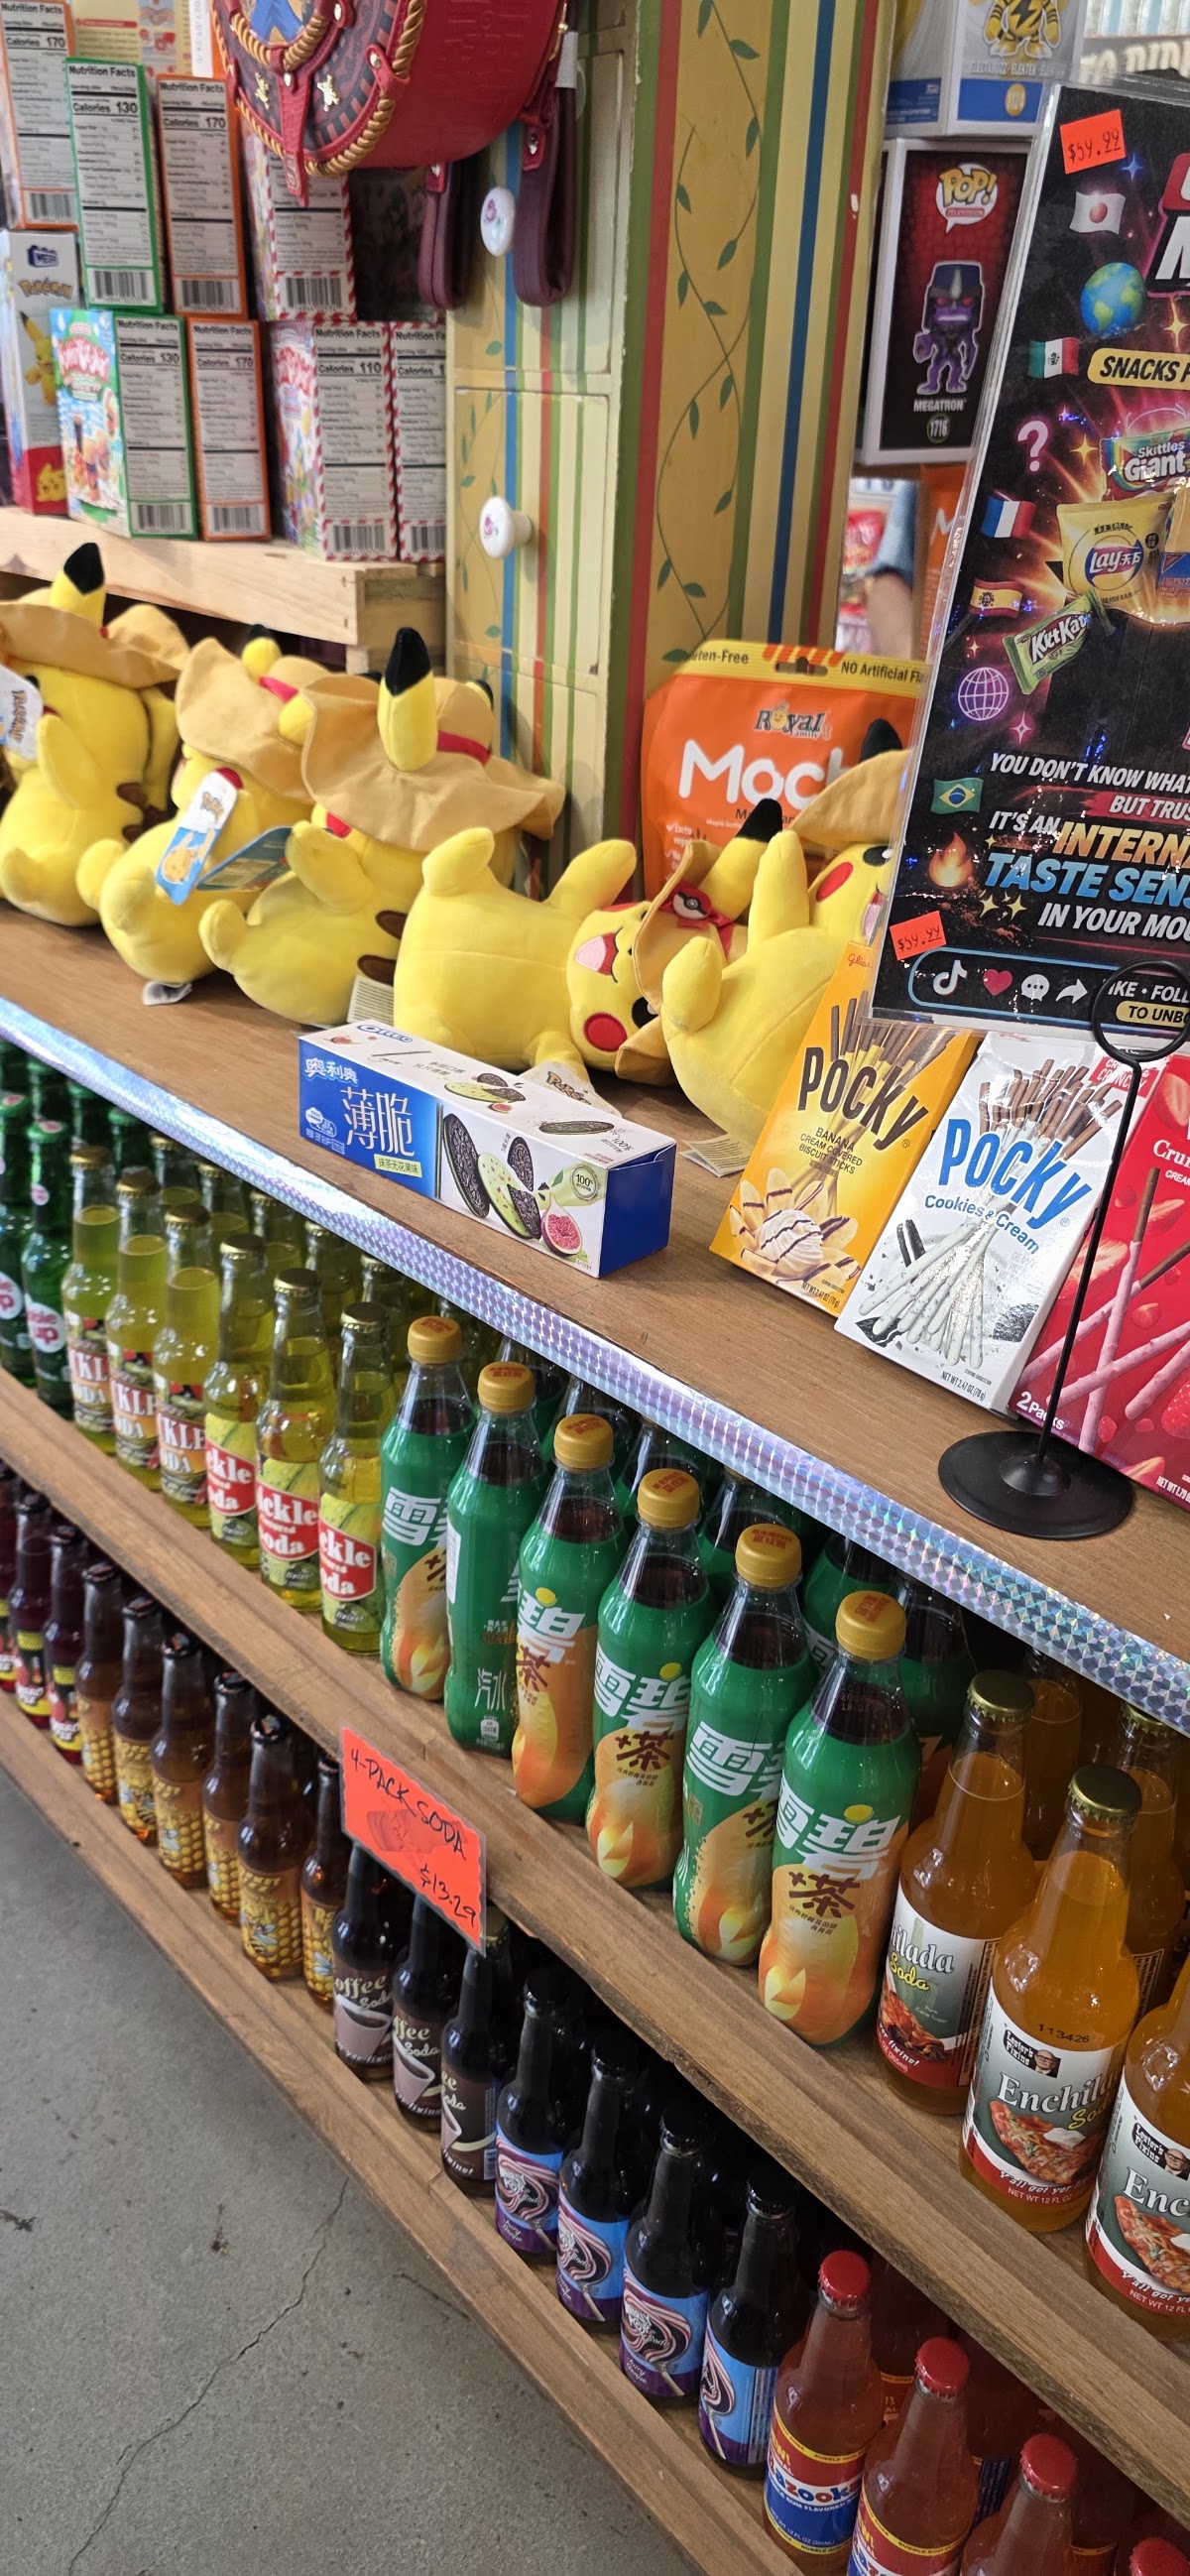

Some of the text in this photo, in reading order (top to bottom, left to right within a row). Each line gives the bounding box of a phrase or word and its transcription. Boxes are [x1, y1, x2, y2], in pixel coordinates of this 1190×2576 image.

[1, 4, 62, 15] Nutrition Facts
[6, 37, 66, 48] Calories 170
[69, 65, 136, 77] Nutrition Facts
[160, 82, 224, 94] Nutrition Facts
[72, 102, 138, 114] Calories 130
[164, 117, 226, 129] Calories 170
[938, 168, 998, 207] POP!
[118, 319, 178, 332] Nutrition Facts
[193, 325, 253, 336] Nutrition Facts
[315, 329, 381, 339] Nutrition Facts
[396, 331, 434, 341] Nutrition
[121, 352, 179, 365] Calories 130
[197, 357, 254, 368] Calories 170
[318, 361, 382, 374] Calories 110
[398, 366, 434, 376] Calories
[1100, 356, 1177, 383] SNACKS
[913, 399, 965, 413] MEGATRON
[929, 419, 948, 437] 1716
[1137, 440, 1186, 458] Skittles
[1125, 451, 1186, 483] Giant
[842, 662, 908, 681] NO Artificial
[678, 739, 850, 811] Moch
[990, 753, 1029, 775] YOU
[1028, 758, 1089, 782] DON'T
[1087, 765, 1145, 789] KNOW
[1110, 795, 1150, 816] BUT
[989, 810, 1029, 832] IT'S
[1028, 815, 1062, 836] AN
[986, 852, 1110, 900] TASTE
[1037, 903, 1076, 927] IN
[1073, 906, 1140, 935] YOUR
[1104, 979, 1139, 998] IKE
[1128, 1005, 1149, 1020] TO
[304, 1057, 358, 1084] 奥利奥
[797, 1046, 929, 1151] POCKY
[340, 1086, 416, 1158] 薄脆
[799, 1133, 863, 1166] CREAM COVERED
[815, 1127, 855, 1153] BANANA
[798, 1144, 828, 1162] BISCUIT
[827, 1156, 856, 1174] STICKS
[938, 1119, 1093, 1231] POCKY
[924, 1194, 985, 1218] Cookies
[996, 1213, 1040, 1255] Cream
[940, 1370, 974, 1395] NET WT 2.47 OZ
[1015, 1391, 1032, 1411] 2
[518, 1587, 587, 1664] 碧
[475, 1666, 508, 1711] 汽水
[594, 1641, 692, 1735] 雪碧
[350, 1748, 467, 1862] 4-PACK SODA
[775, 1774, 901, 1882] 雪碧
[419, 1863, 477, 1928] $13.29
[890, 1951, 930, 1992] Soda
[335, 1974, 387, 1999] offee
[393, 2015, 430, 2040] ffee
[1038, 2024, 1091, 2043] 113426
[1005, 2041, 1031, 2067] Fixins
[1006, 2033, 1034, 2058] Lester's
[1133, 2135, 1161, 2164] Fixins
[1135, 2124, 1164, 2156] Lester's
[999, 2168, 1028, 2189] Y'all
[1027, 2184, 1049, 2195] got
[1123, 2166, 1190, 2218] Enc
[1008, 2187, 1025, 2200] NET
[1024, 2193, 1038, 2204] WT
[1052, 2195, 1061, 2205] FL
[1062, 2193, 1074, 2203] OZ
[1121, 2269, 1151, 2293] Y'all
[1151, 2289, 1174, 2303] got
[1129, 2288, 1187, 2314] NET WT 12 FL
